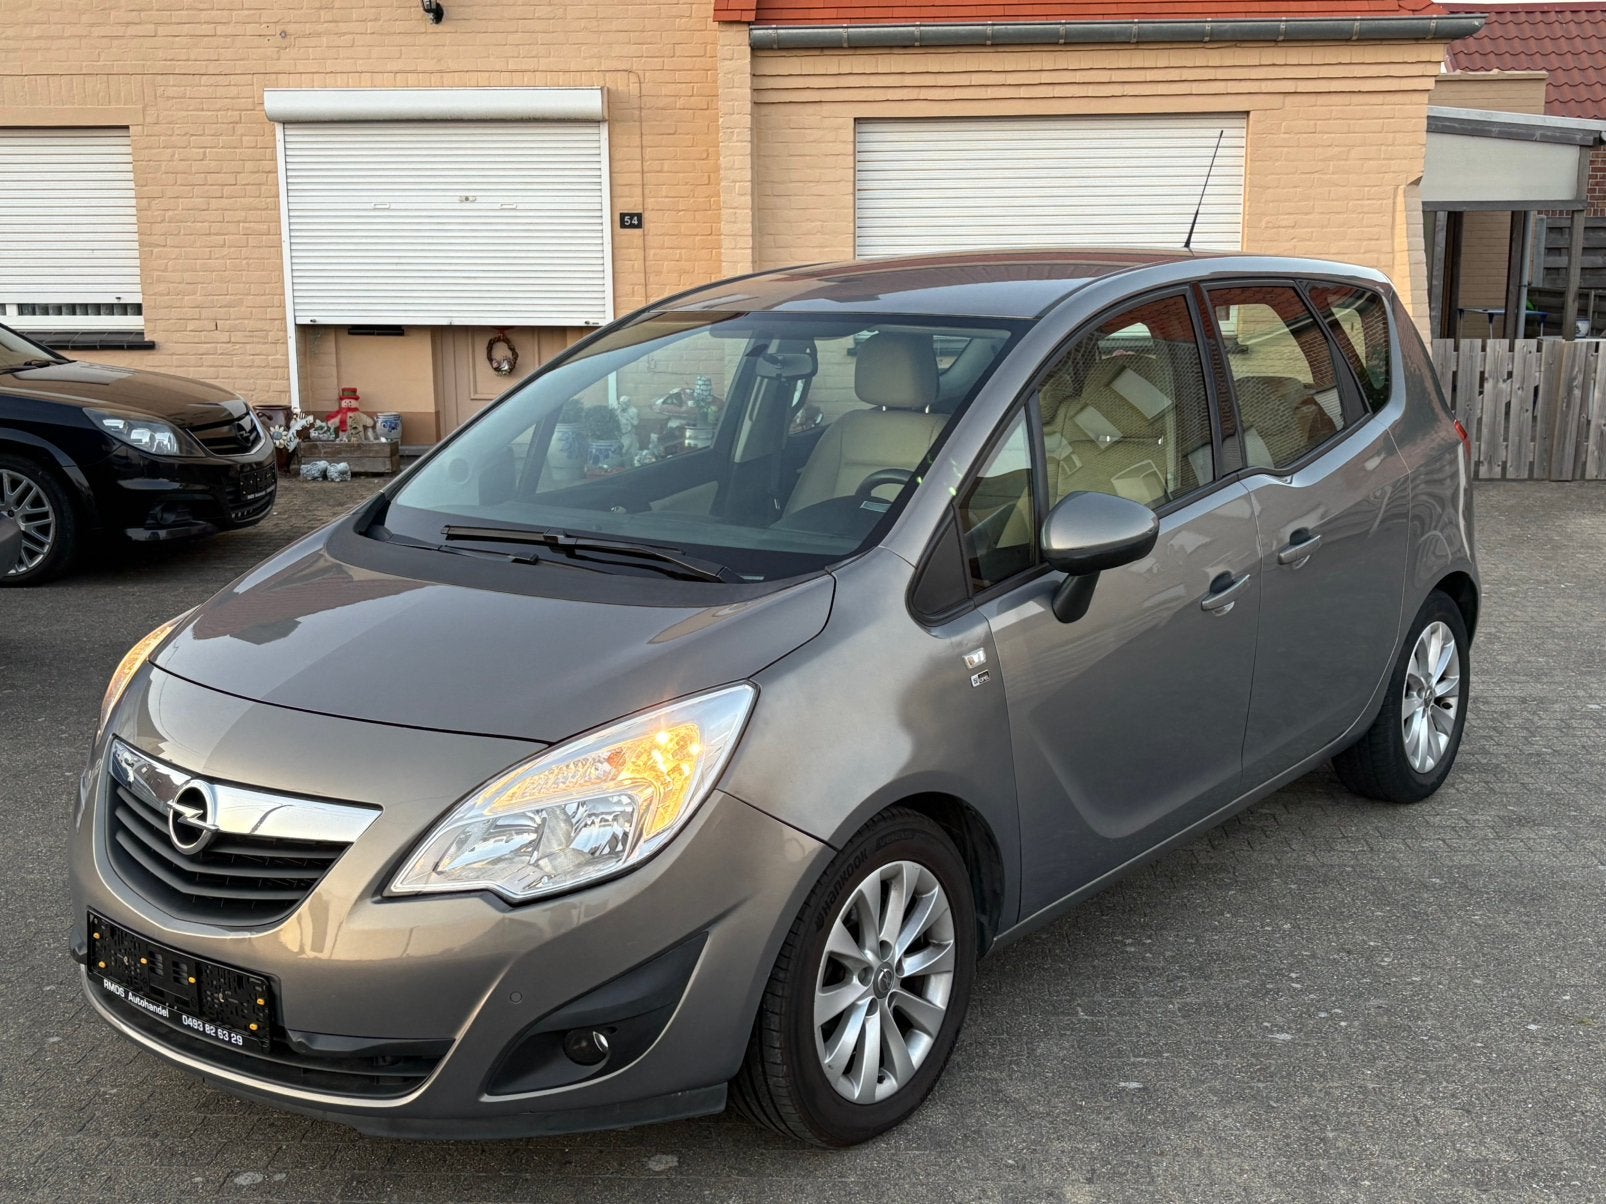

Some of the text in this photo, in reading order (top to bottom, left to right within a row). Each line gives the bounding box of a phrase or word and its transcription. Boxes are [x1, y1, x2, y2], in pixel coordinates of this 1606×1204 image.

[624, 215, 639, 226] 54
[128, 991, 169, 1018] Autohandel
[182, 1014, 203, 1032] 0493
[204, 1023, 216, 1037] 82
[217, 1028, 229, 1041] 63
[230, 1033, 243, 1046] 29
